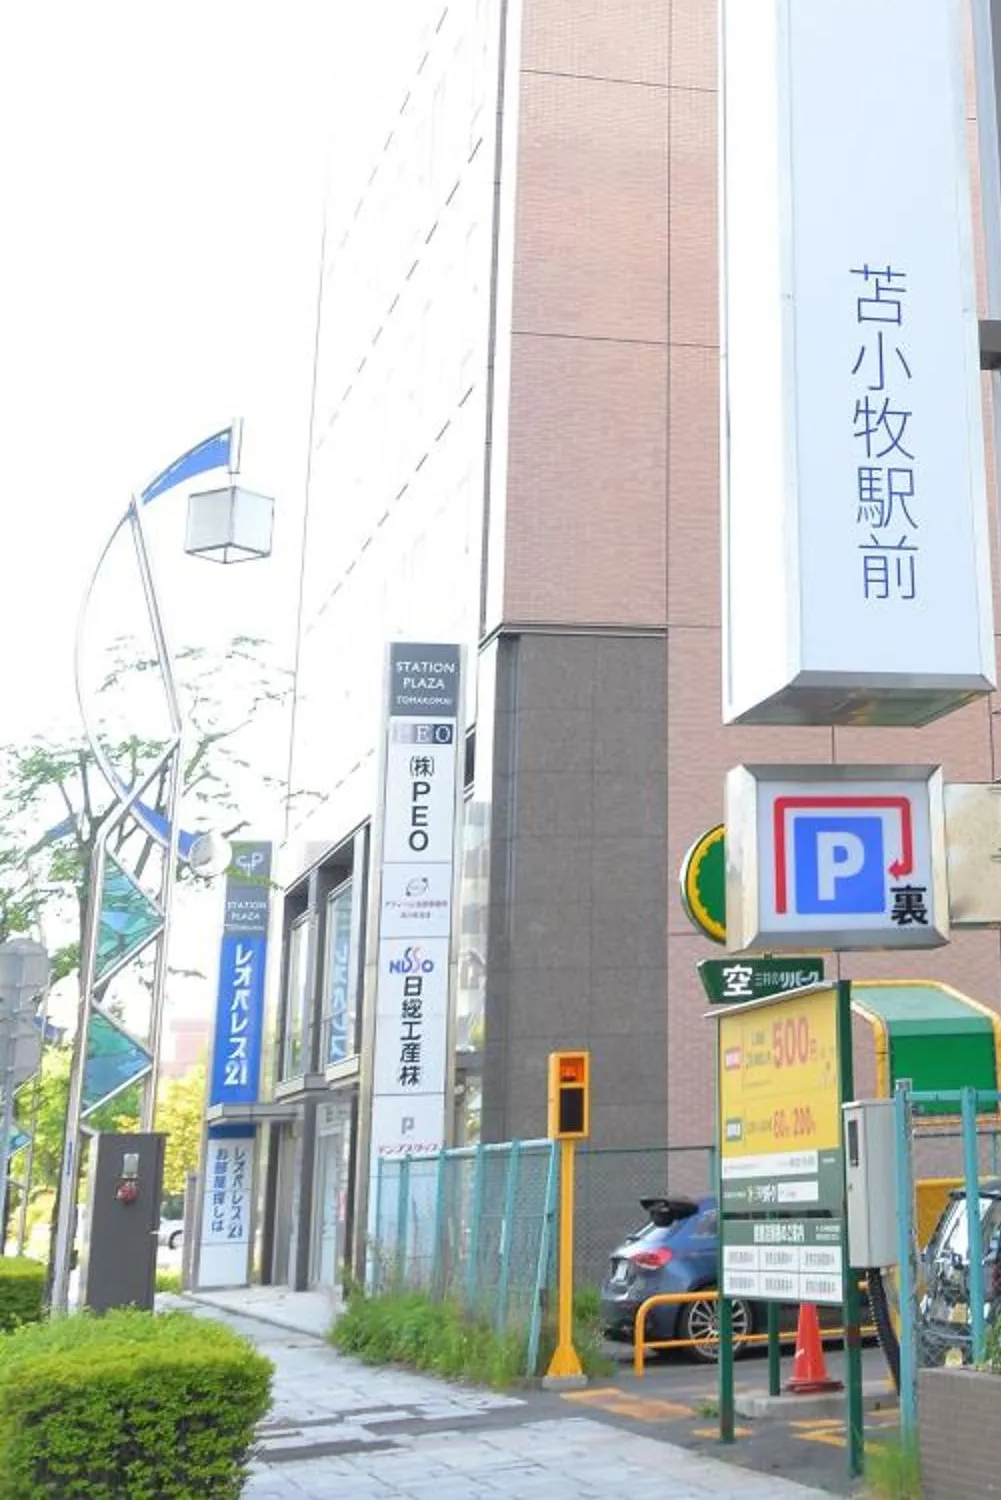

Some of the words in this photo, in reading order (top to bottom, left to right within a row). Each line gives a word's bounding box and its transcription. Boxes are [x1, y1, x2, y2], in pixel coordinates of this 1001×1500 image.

[849, 264, 919, 599] 苫小牧駅前
[396, 661, 455, 673] STATION
[403, 678, 445, 689] PLAZA
[816, 832, 866, 900] P
[889, 885, 929, 926] 裏
[723, 964, 753, 996] 空
[223, 943, 252, 1085] レオパレス21
